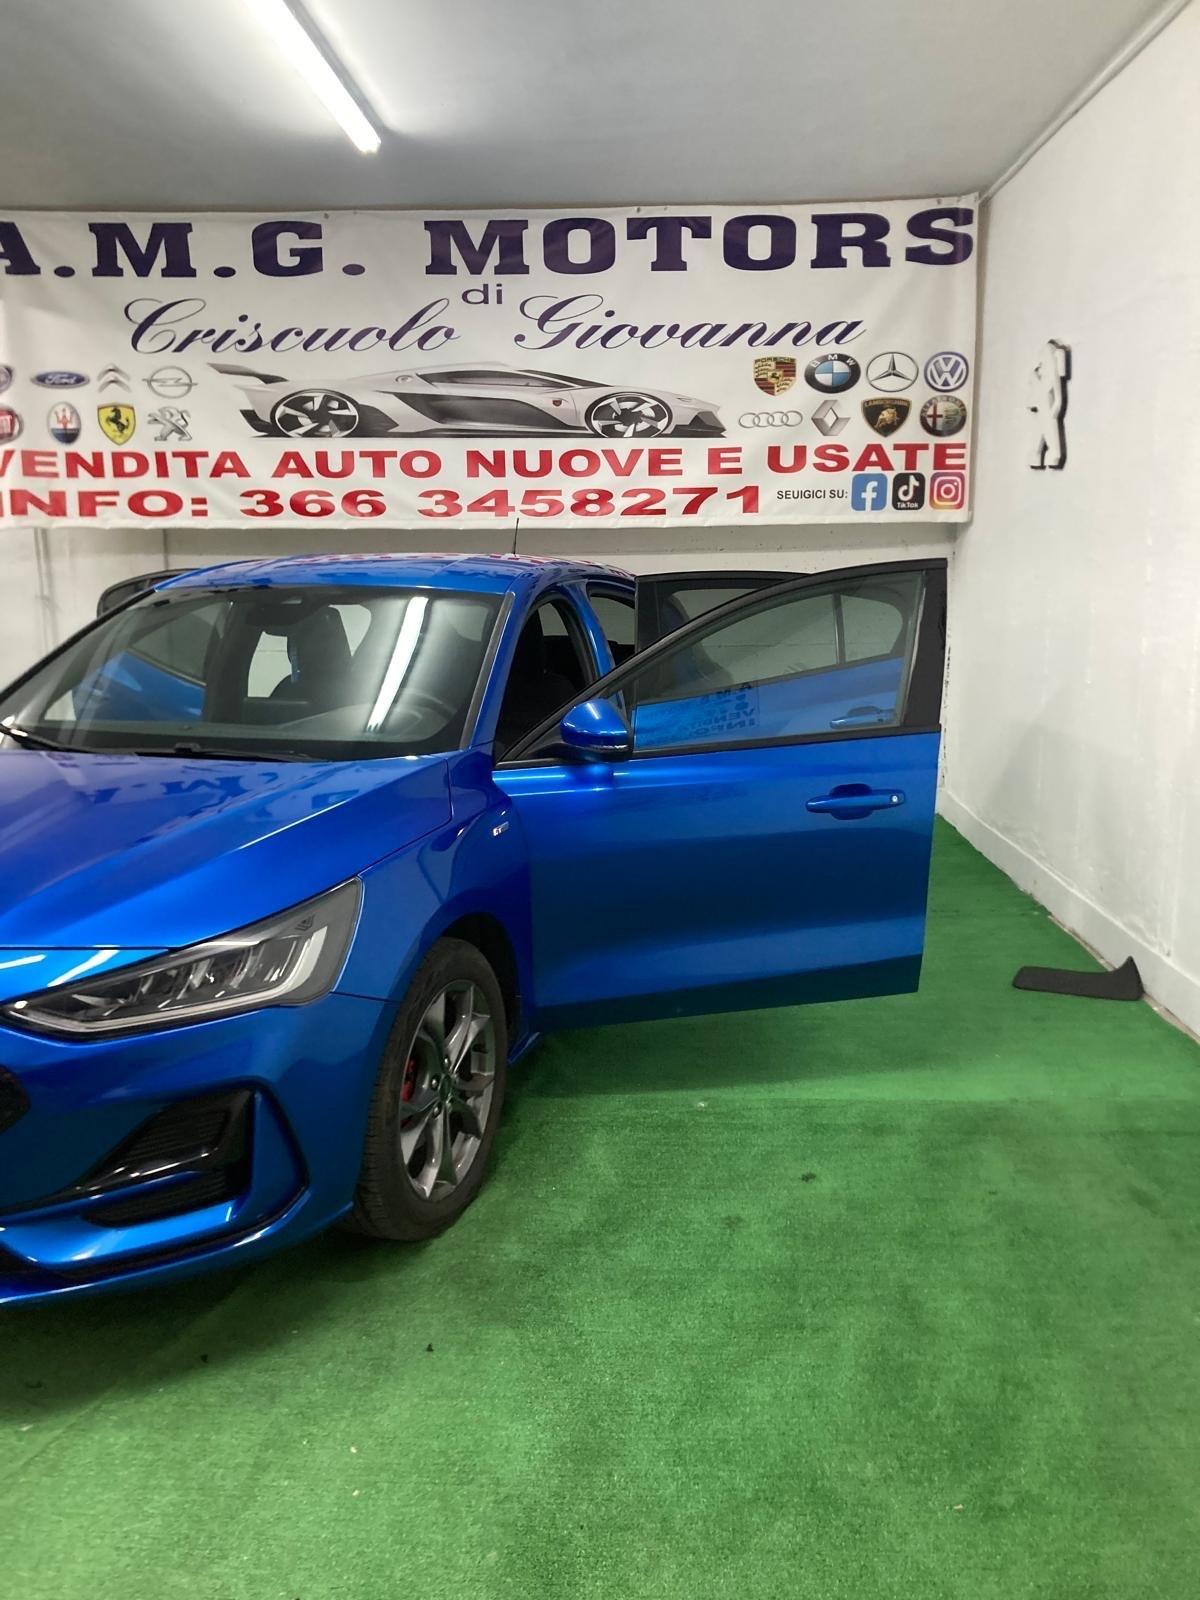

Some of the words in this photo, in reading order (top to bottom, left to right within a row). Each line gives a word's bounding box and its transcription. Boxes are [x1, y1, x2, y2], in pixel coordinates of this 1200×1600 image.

[423, 207, 974, 275] MOTORS
[461, 283, 503, 305] di
[124, 298, 461, 354] Criscuolo
[514, 294, 866, 350] Giovanna
[272, 450, 443, 480] AUTO
[466, 447, 683, 478] NUOVE
[708, 446, 742, 475] E
[767, 442, 966, 475] USATE
[0, 489, 208, 518] NFO:
[240, 488, 387, 518] 366
[417, 485, 760, 518] 3458271
[777, 489, 826, 500] SEUIGICI
[829, 488, 848, 499] SU:
